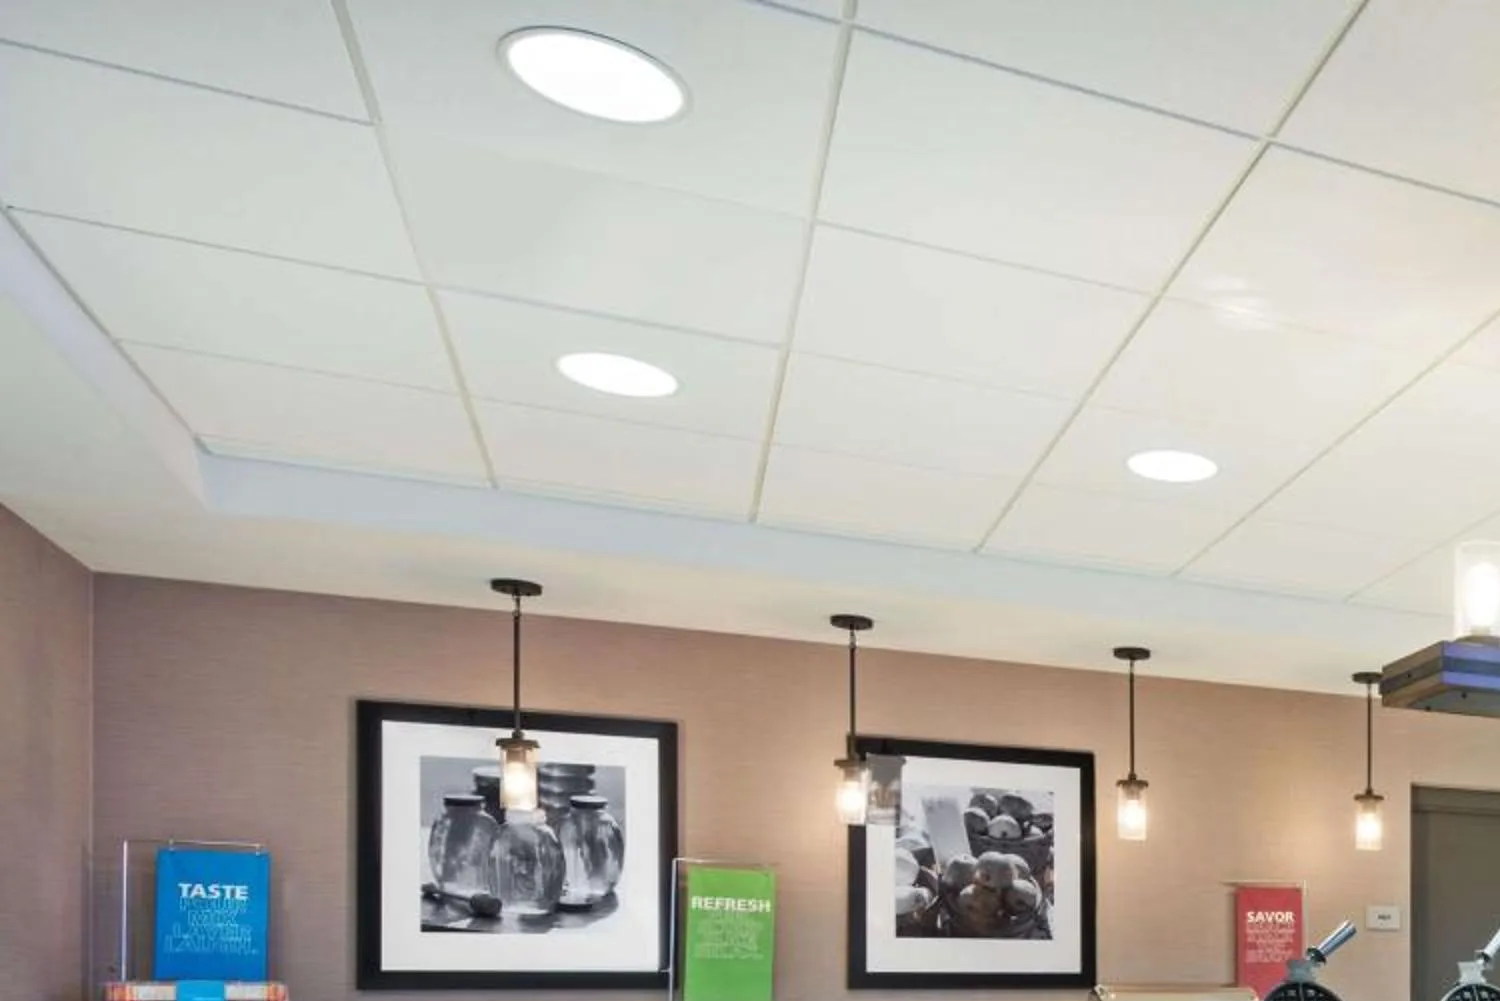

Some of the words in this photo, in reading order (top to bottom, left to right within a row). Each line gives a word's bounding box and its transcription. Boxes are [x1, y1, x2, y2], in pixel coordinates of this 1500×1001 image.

[177, 883, 249, 900] TASTE
[691, 895, 772, 913] REFRESH
[1246, 911, 1296, 923] SAVOR
